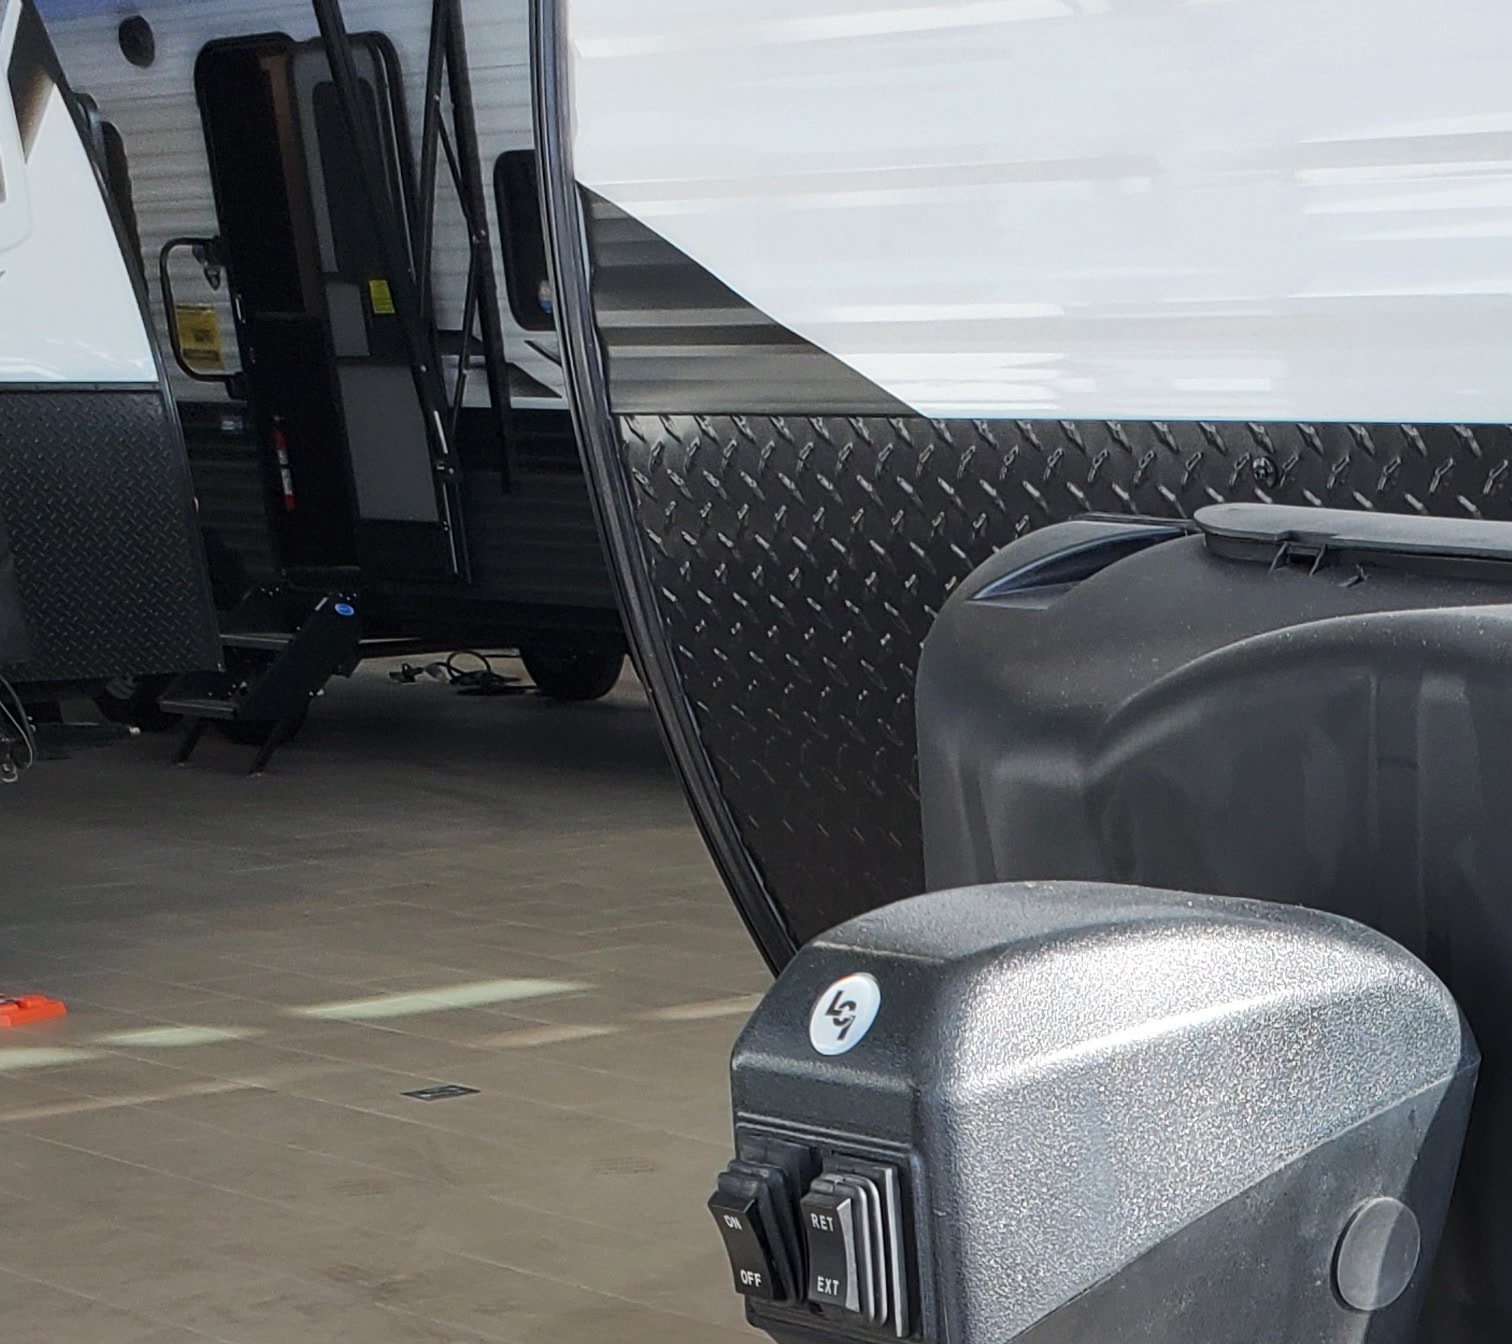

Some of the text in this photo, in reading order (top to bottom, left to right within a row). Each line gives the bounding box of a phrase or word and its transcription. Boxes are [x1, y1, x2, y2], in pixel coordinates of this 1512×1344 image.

[724, 1214, 742, 1231] ON
[810, 1213, 834, 1232] RET
[740, 1269, 762, 1288] OFF
[817, 1275, 839, 1296] EXT
